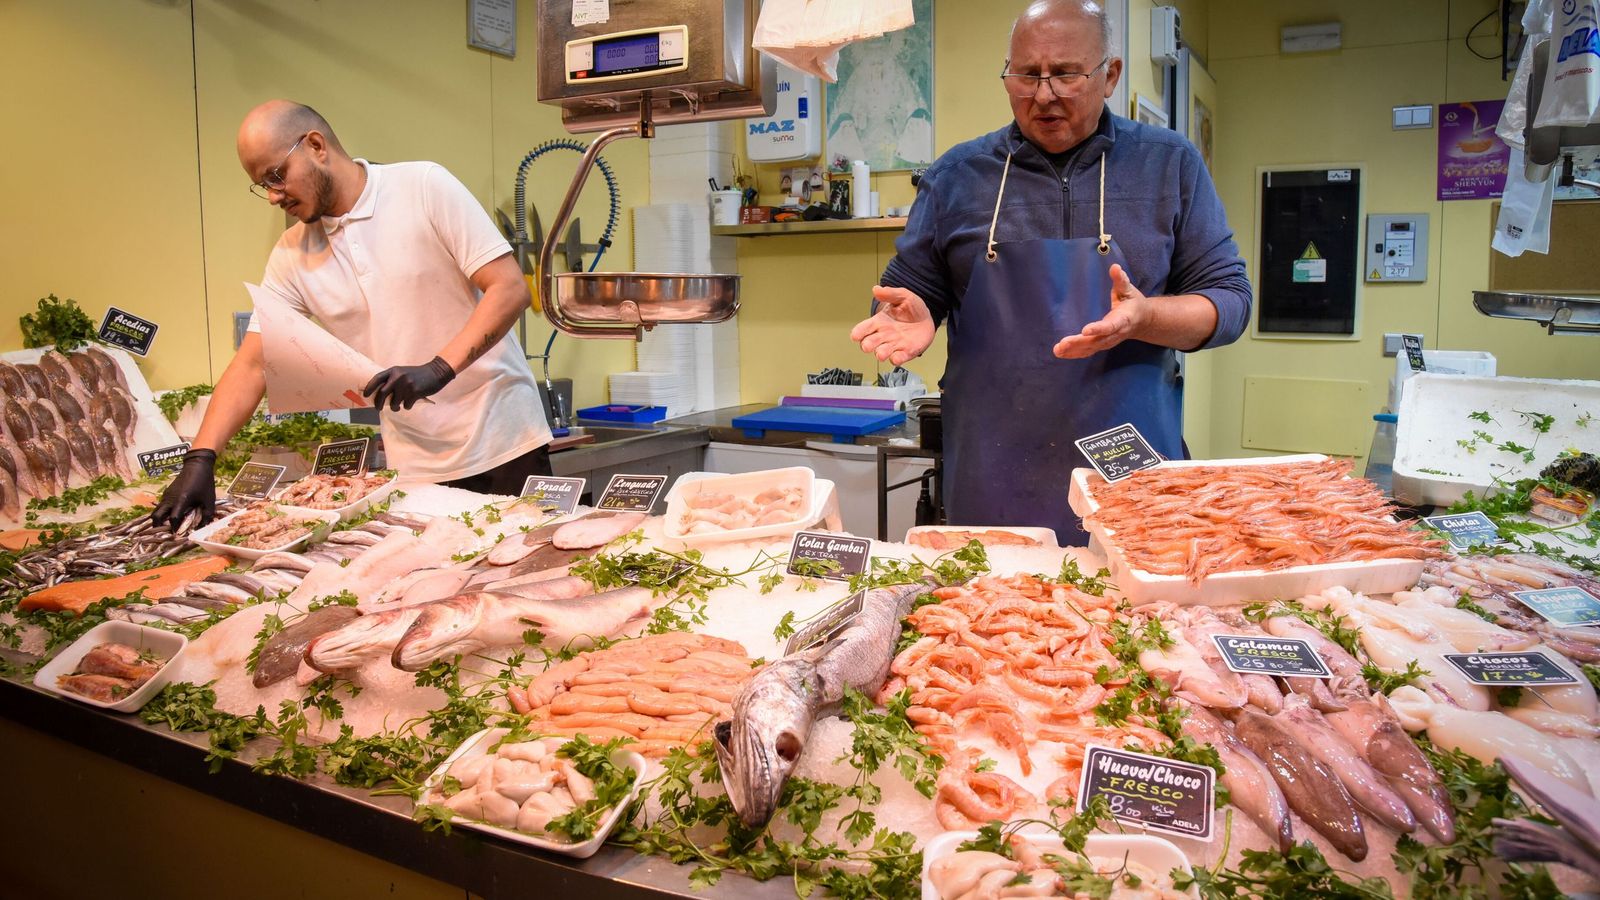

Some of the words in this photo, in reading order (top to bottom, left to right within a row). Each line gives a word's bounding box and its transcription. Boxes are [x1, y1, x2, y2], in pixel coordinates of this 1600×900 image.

[749, 119, 795, 135] MAZ
[772, 135, 795, 143] suma
[1478, 179, 1495, 187] YUN
[113, 314, 151, 334] Acedias
[1085, 438, 1113, 451] GAMBA
[1102, 444, 1132, 457] HUELVA
[142, 447, 188, 462] P.Espada
[322, 455, 356, 465] FRESCOS
[534, 481, 573, 492] Rosada
[612, 479, 658, 490] Lenguado
[799, 536, 825, 549] Colas
[826, 539, 865, 554] Gambas
[1227, 639, 1300, 652] Calamar
[1235, 647, 1298, 658] FRESCO
[1466, 656, 1529, 665] Chocos
[1098, 755, 1201, 790] Huevo/Choco
[1110, 776, 1184, 800] FRESCO
[1171, 819, 1200, 831] ADELA
